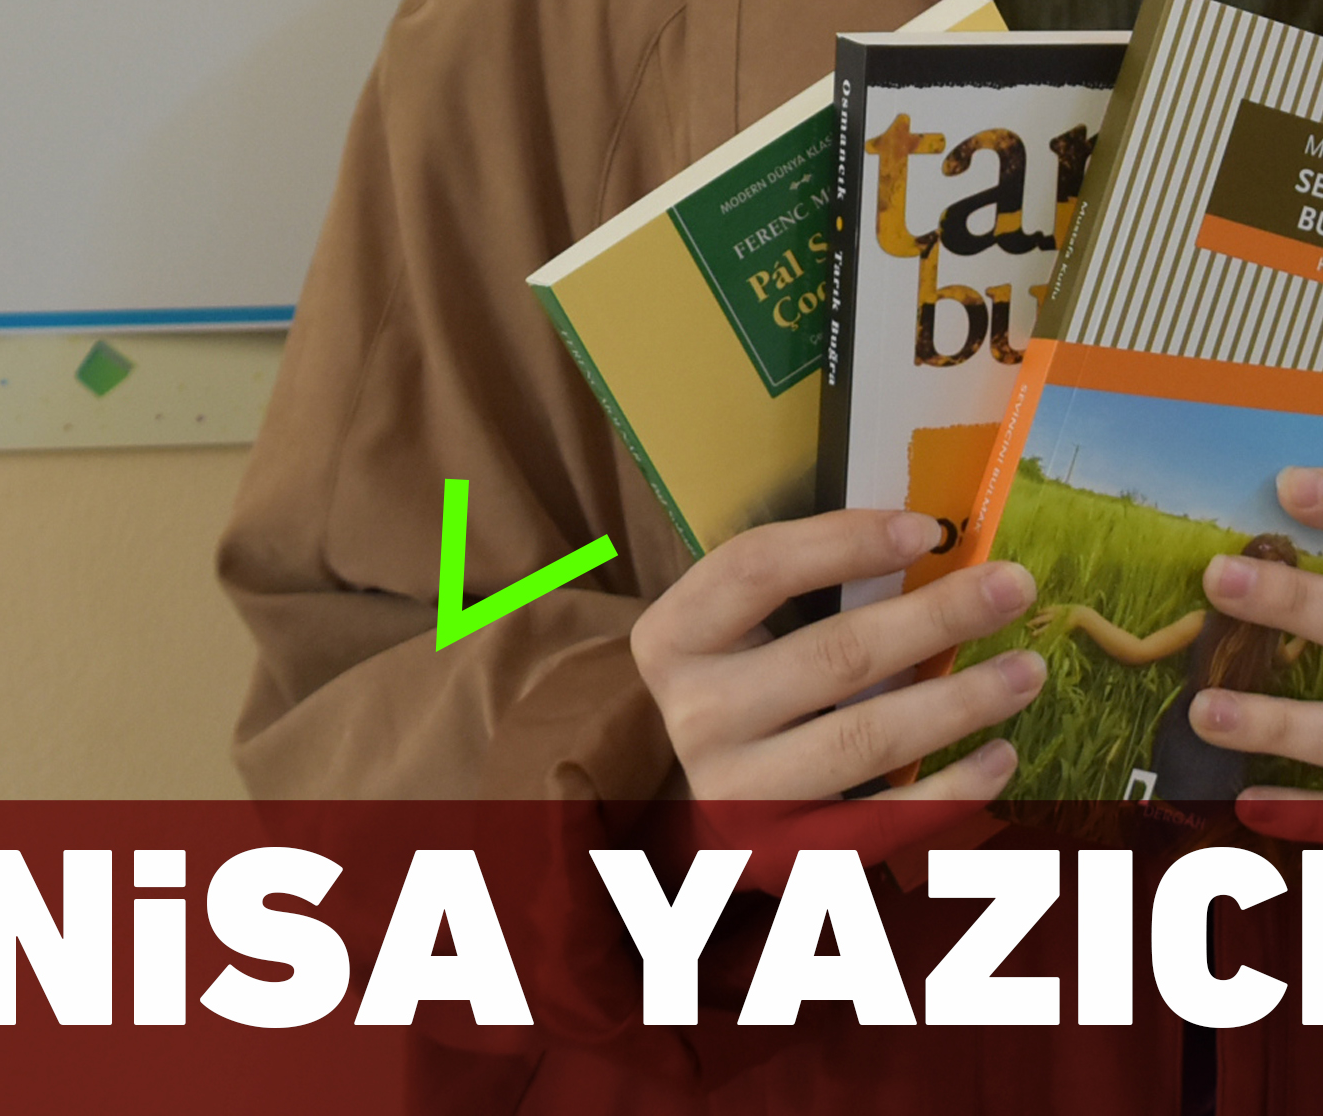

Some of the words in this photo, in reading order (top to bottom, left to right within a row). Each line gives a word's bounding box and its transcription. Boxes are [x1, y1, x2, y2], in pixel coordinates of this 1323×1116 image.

[836, 78, 851, 201] Osmancık
[719, 178, 767, 215] MODERN
[767, 153, 806, 184] DÜNYA
[806, 133, 833, 159] KLAS
[733, 203, 809, 260] FERENC
[1064, 201, 1088, 259] Mustafa
[746, 249, 804, 303] Pál
[831, 250, 844, 312] Tarık
[1050, 262, 1068, 300] Kutlu
[975, 467, 1000, 532] BULMAK
